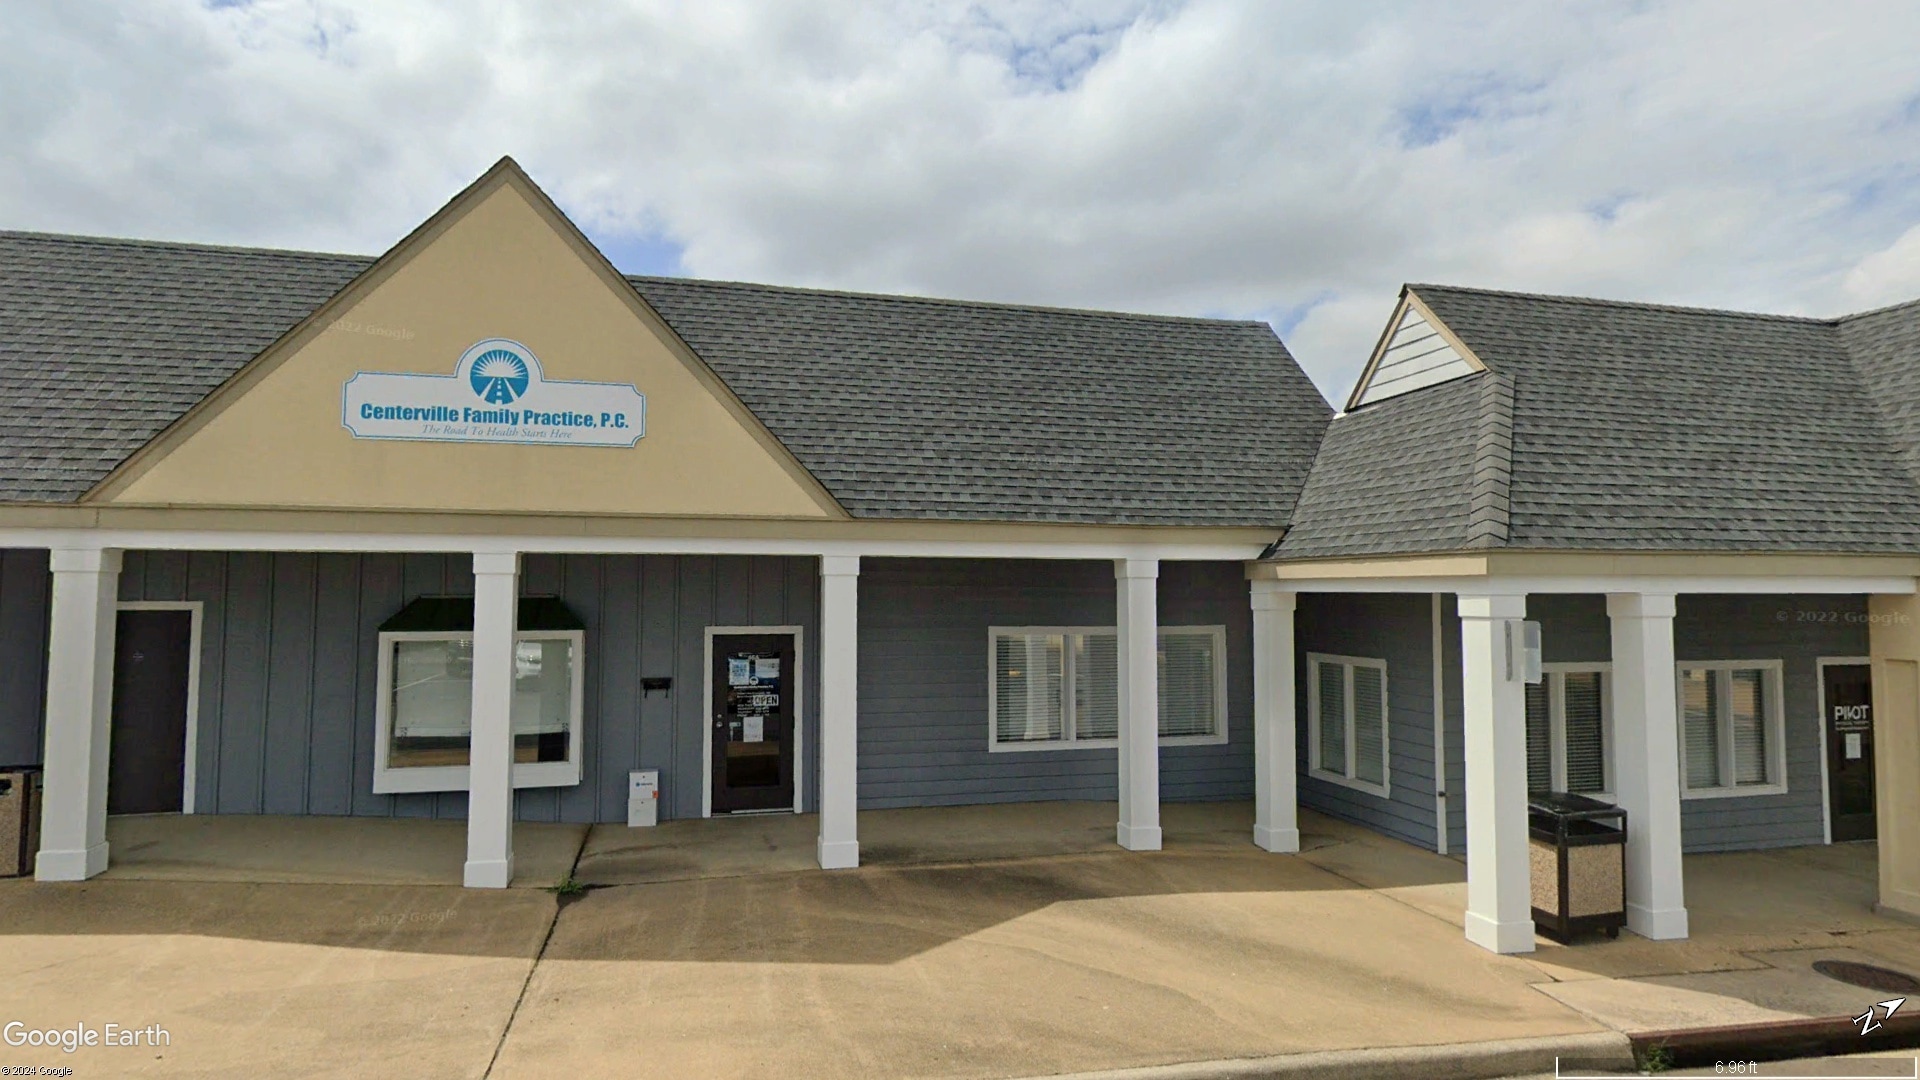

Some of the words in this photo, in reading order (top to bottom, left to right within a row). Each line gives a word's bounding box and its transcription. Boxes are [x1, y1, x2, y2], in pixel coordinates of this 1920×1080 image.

[361, 403, 459, 422] Centerville
[463, 407, 520, 426] Family
[523, 409, 597, 428] Practice,
[600, 412, 630, 429] P.C.
[422, 423, 441, 435] The
[443, 425, 468, 436] Road
[472, 426, 483, 436] To
[486, 427, 519, 438] Health
[520, 428, 548, 439] Starts
[549, 429, 573, 439] Here
[755, 695, 778, 705] OPEN
